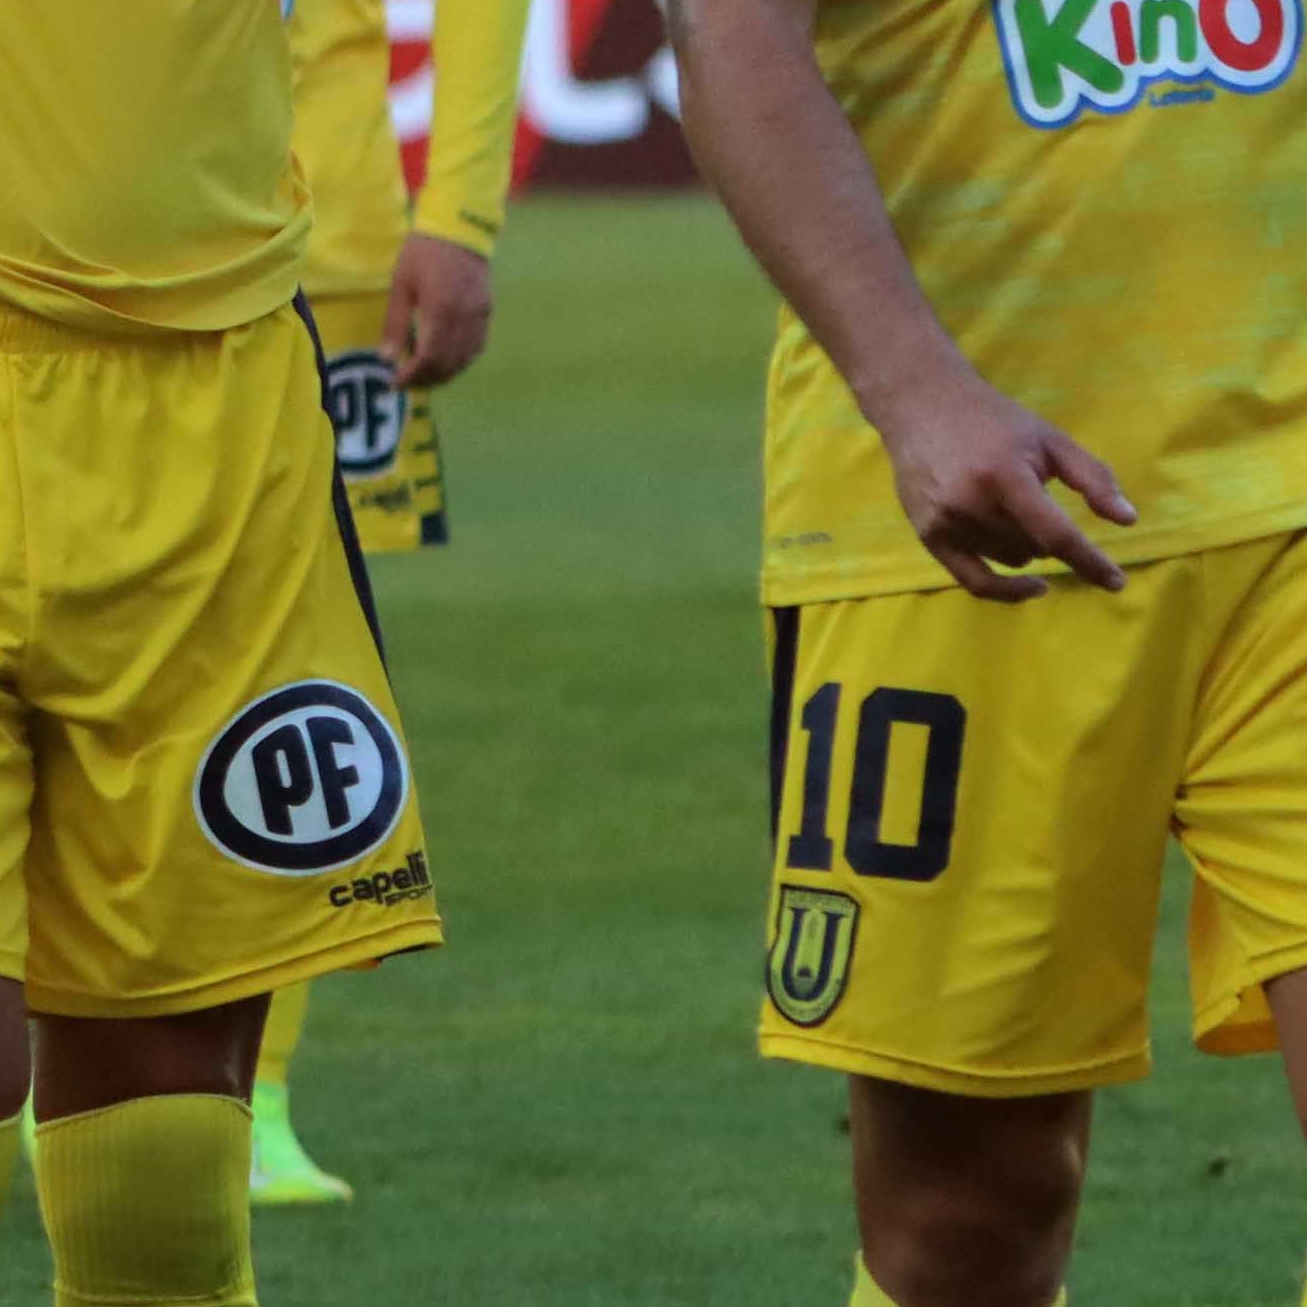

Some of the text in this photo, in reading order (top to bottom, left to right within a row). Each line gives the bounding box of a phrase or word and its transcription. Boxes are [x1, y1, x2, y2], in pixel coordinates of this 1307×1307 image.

[251, 715, 361, 836] PF
[786, 682, 968, 883] 10
[329, 849, 431, 908] capelli
